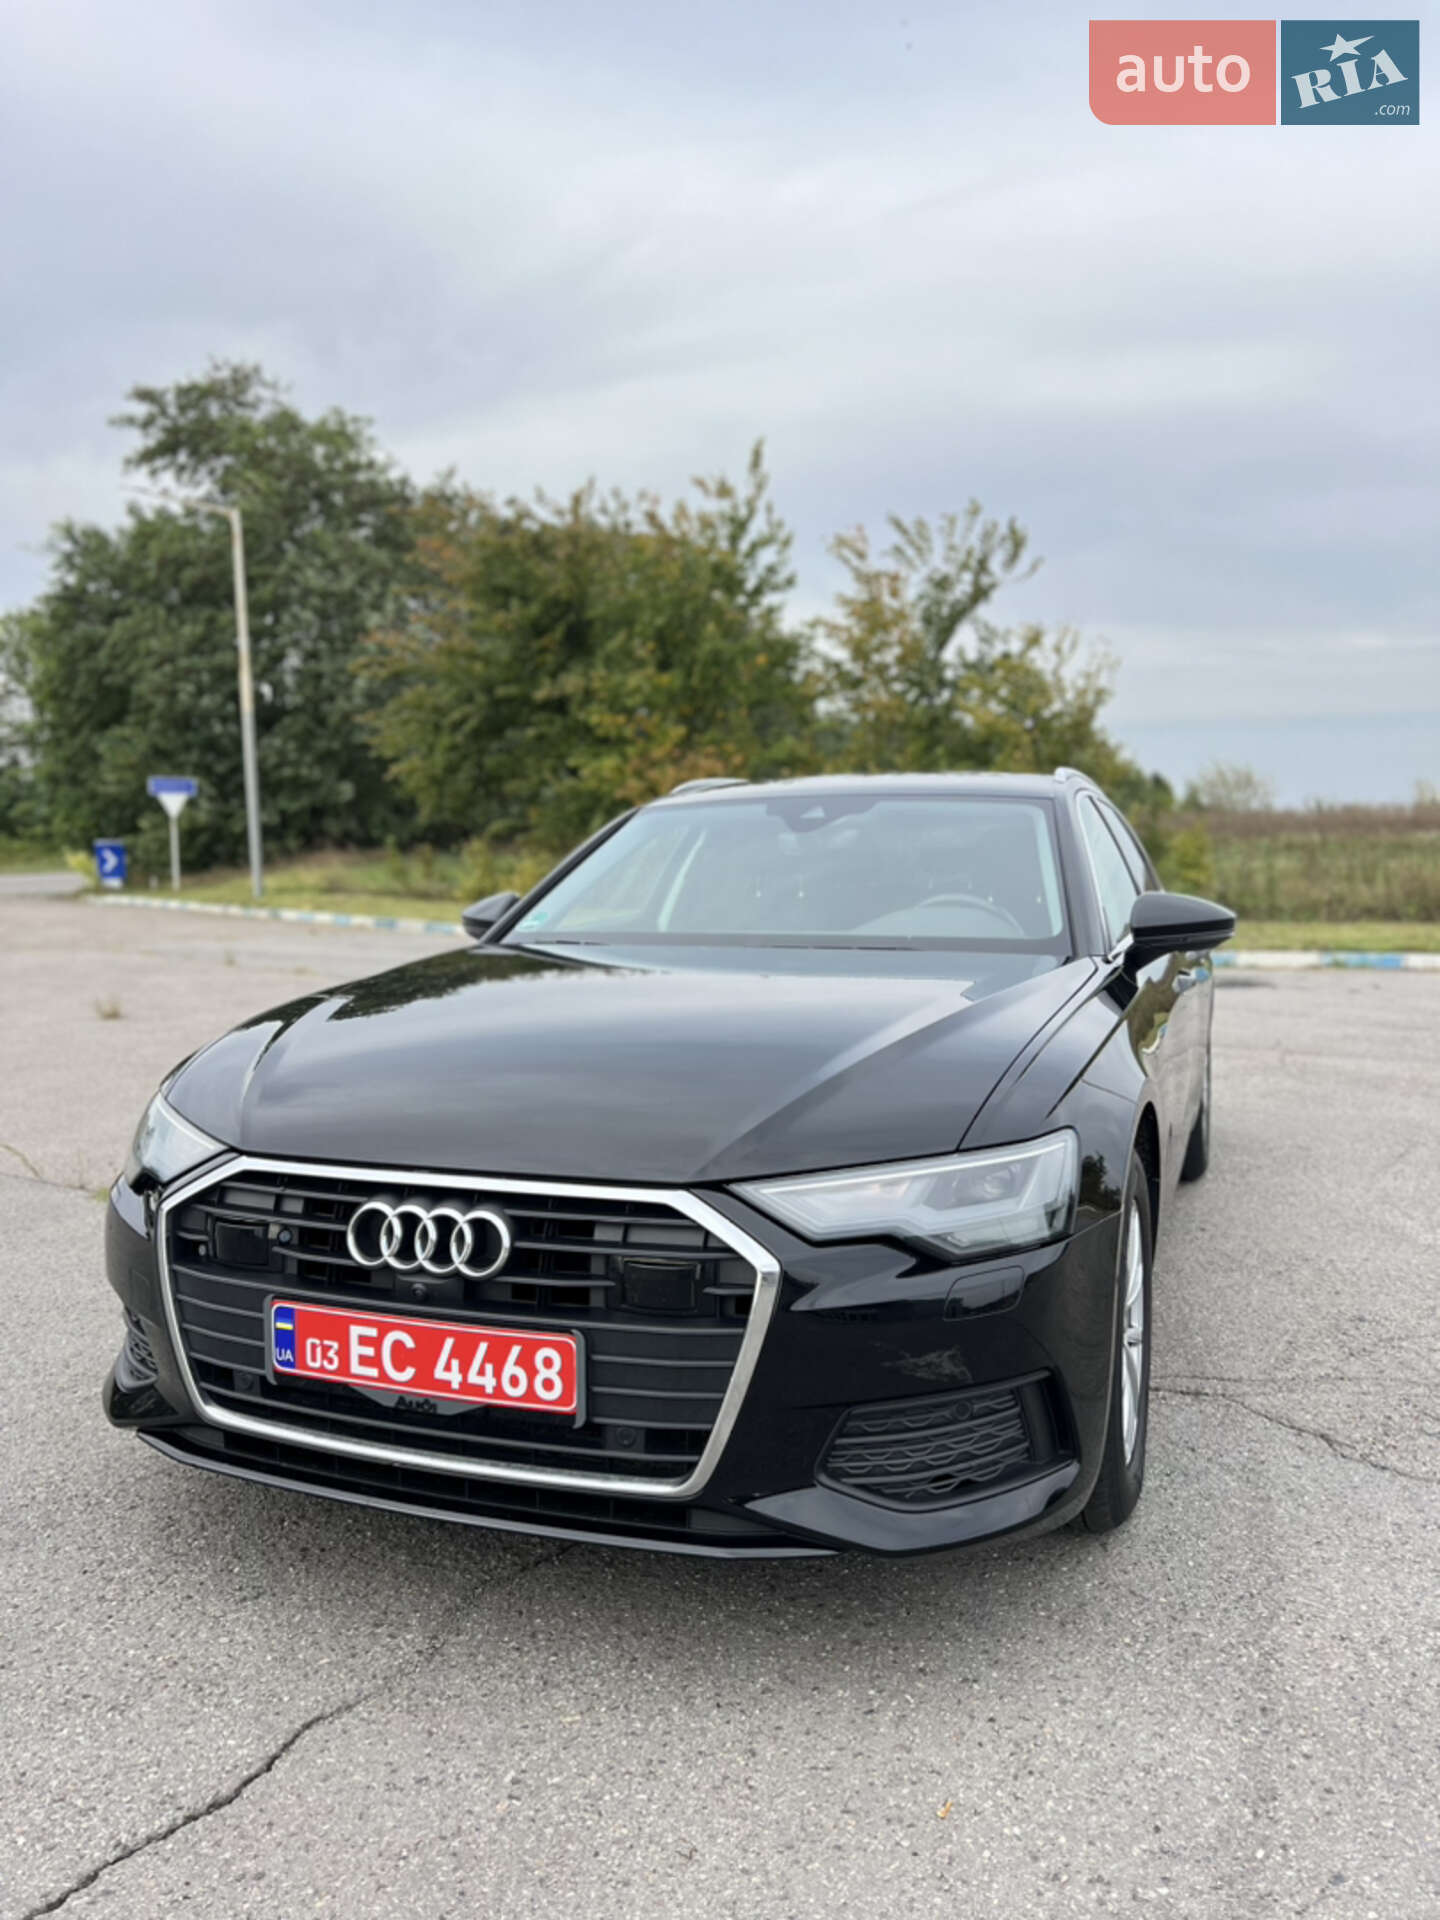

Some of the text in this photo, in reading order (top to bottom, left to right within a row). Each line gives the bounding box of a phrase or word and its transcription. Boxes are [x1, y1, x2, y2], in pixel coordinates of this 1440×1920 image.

[276, 1347, 294, 1363] UA
[306, 1324, 563, 1401] 03 EC 4468
